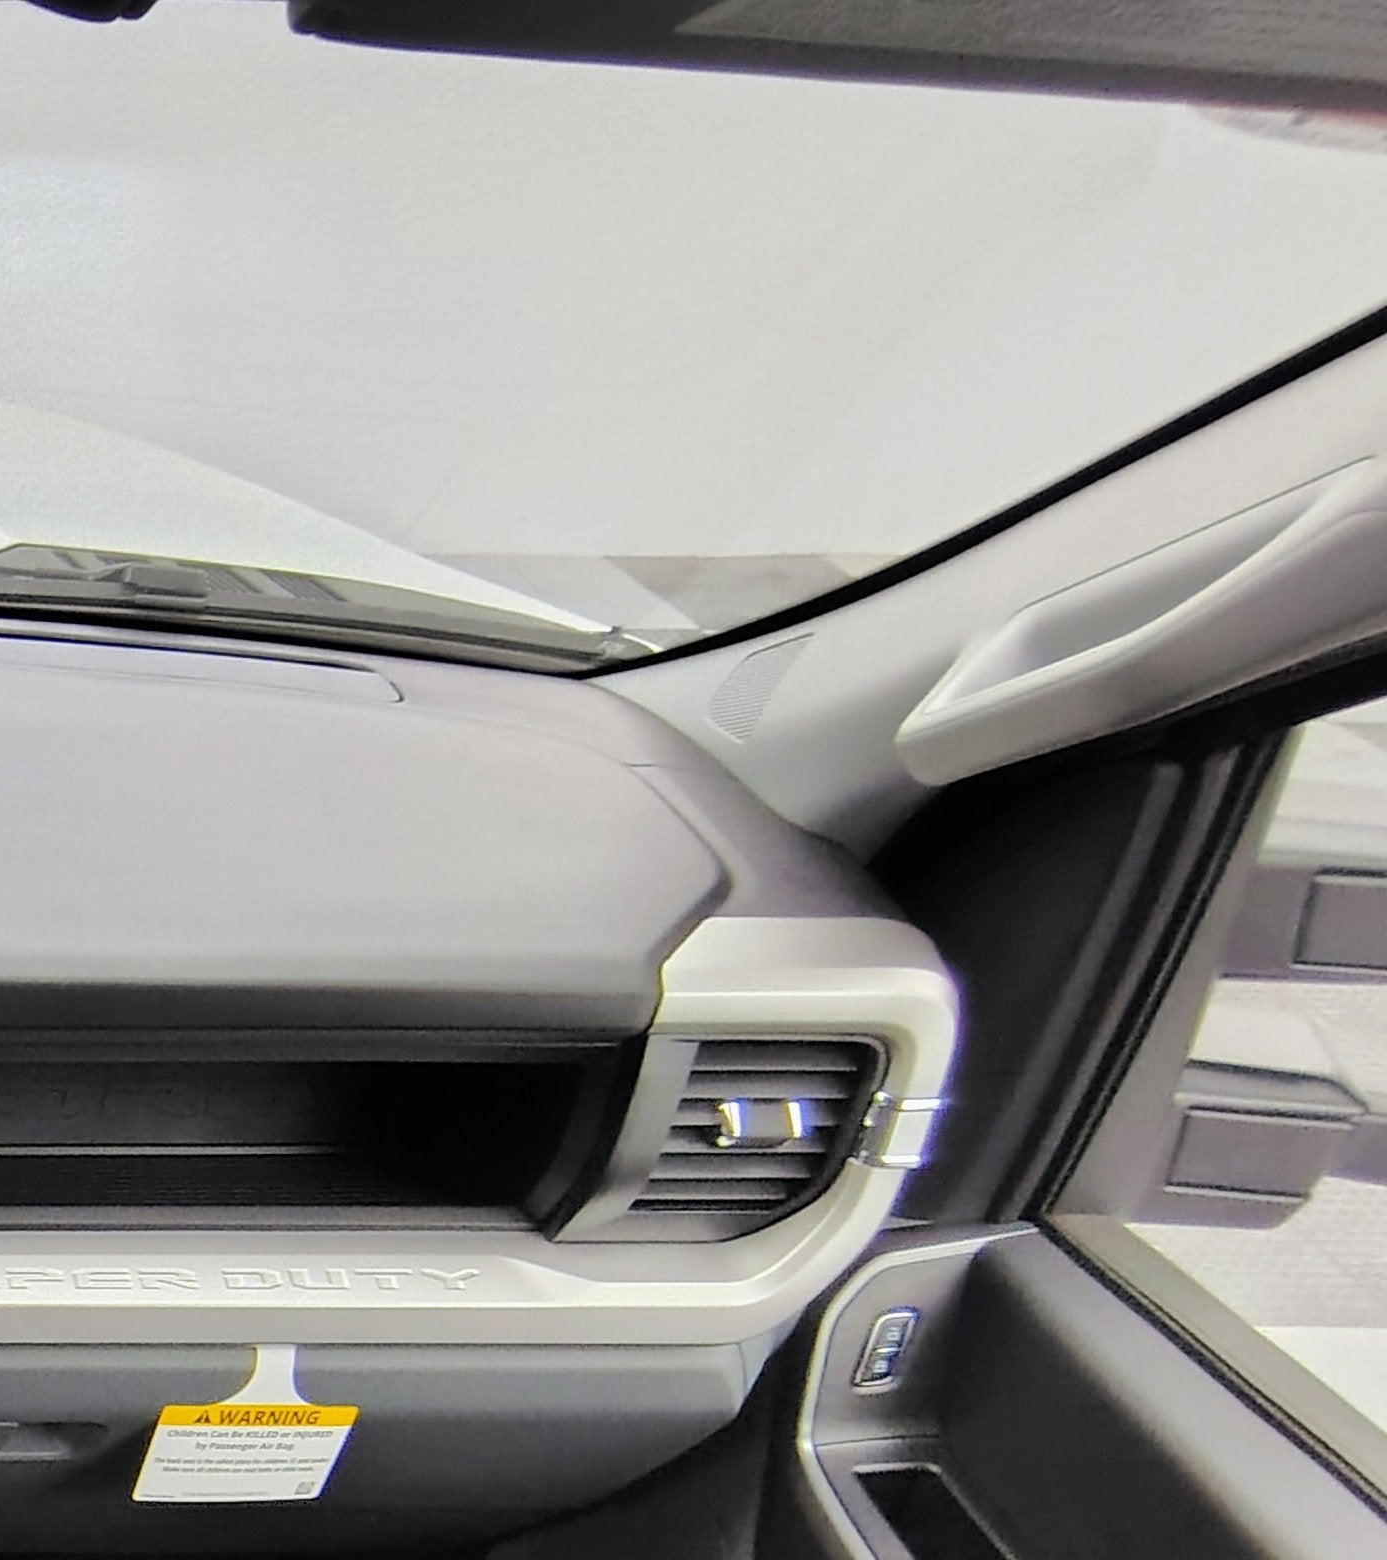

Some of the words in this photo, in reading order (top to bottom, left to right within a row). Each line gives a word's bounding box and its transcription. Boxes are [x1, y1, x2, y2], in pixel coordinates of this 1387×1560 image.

[221, 1267, 481, 1291] DUTY
[218, 1410, 321, 1425] WARNING
[166, 1429, 209, 1439] Children
[210, 1430, 229, 1439] Can
[231, 1431, 244, 1439] Be
[245, 1430, 279, 1439] KILLED
[293, 1430, 333, 1440] INJURED
[195, 1441, 207, 1451] by
[208, 1441, 258, 1452] Passenger
[259, 1442, 274, 1450] Air
[275, 1442, 295, 1451] Bag
